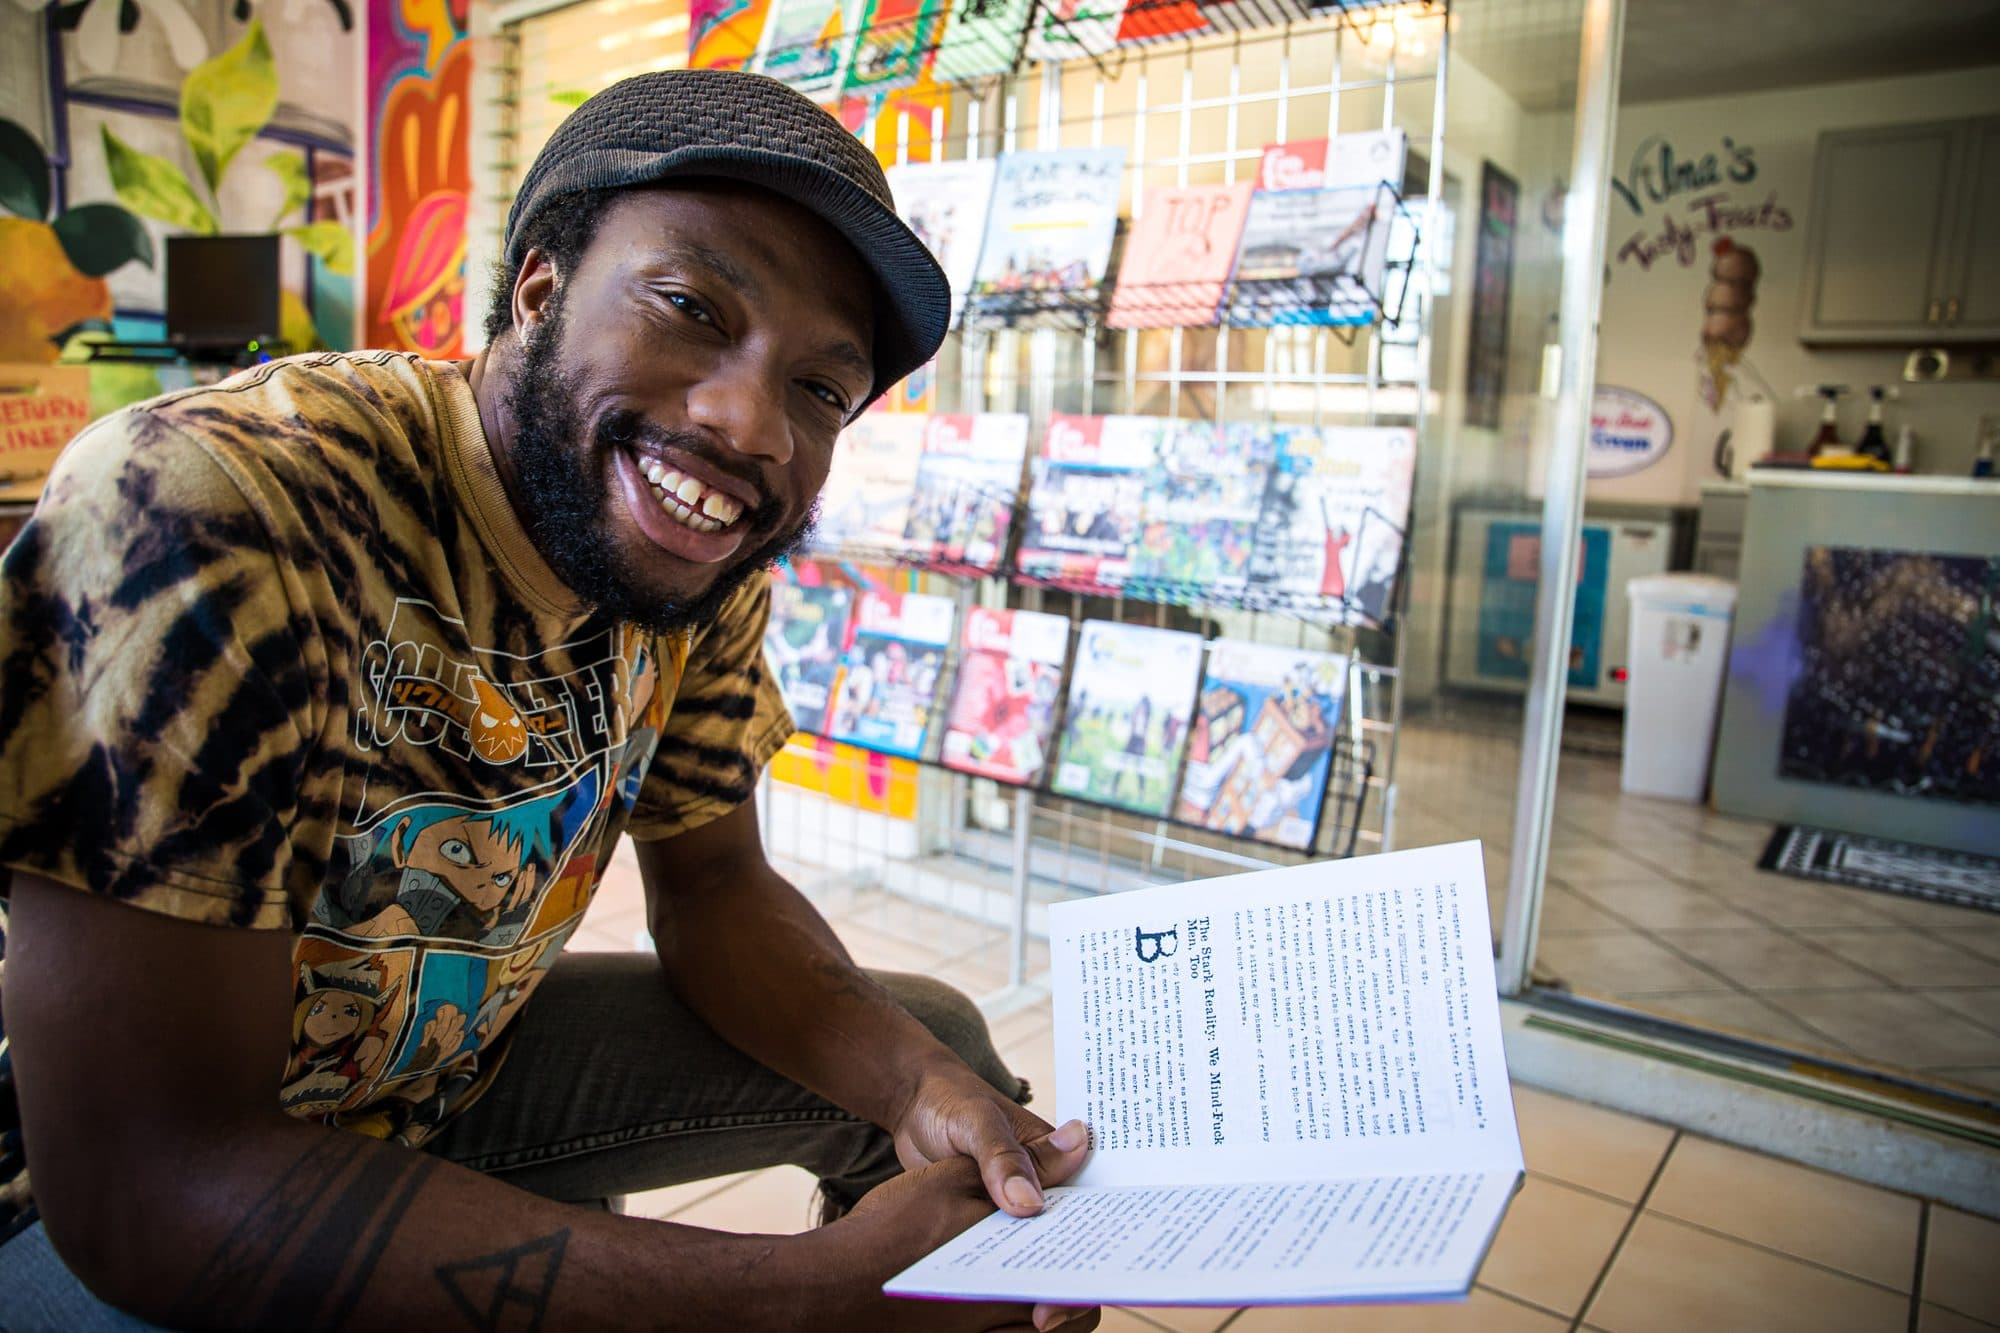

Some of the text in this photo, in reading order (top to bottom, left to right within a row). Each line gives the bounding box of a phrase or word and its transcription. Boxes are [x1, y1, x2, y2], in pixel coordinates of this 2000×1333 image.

[0, 396, 88, 425] ETURN
[1185, 918, 1201, 979] Men, Too
[1198, 916, 1227, 1145] The Stark Reality: We Mind-Fuck
